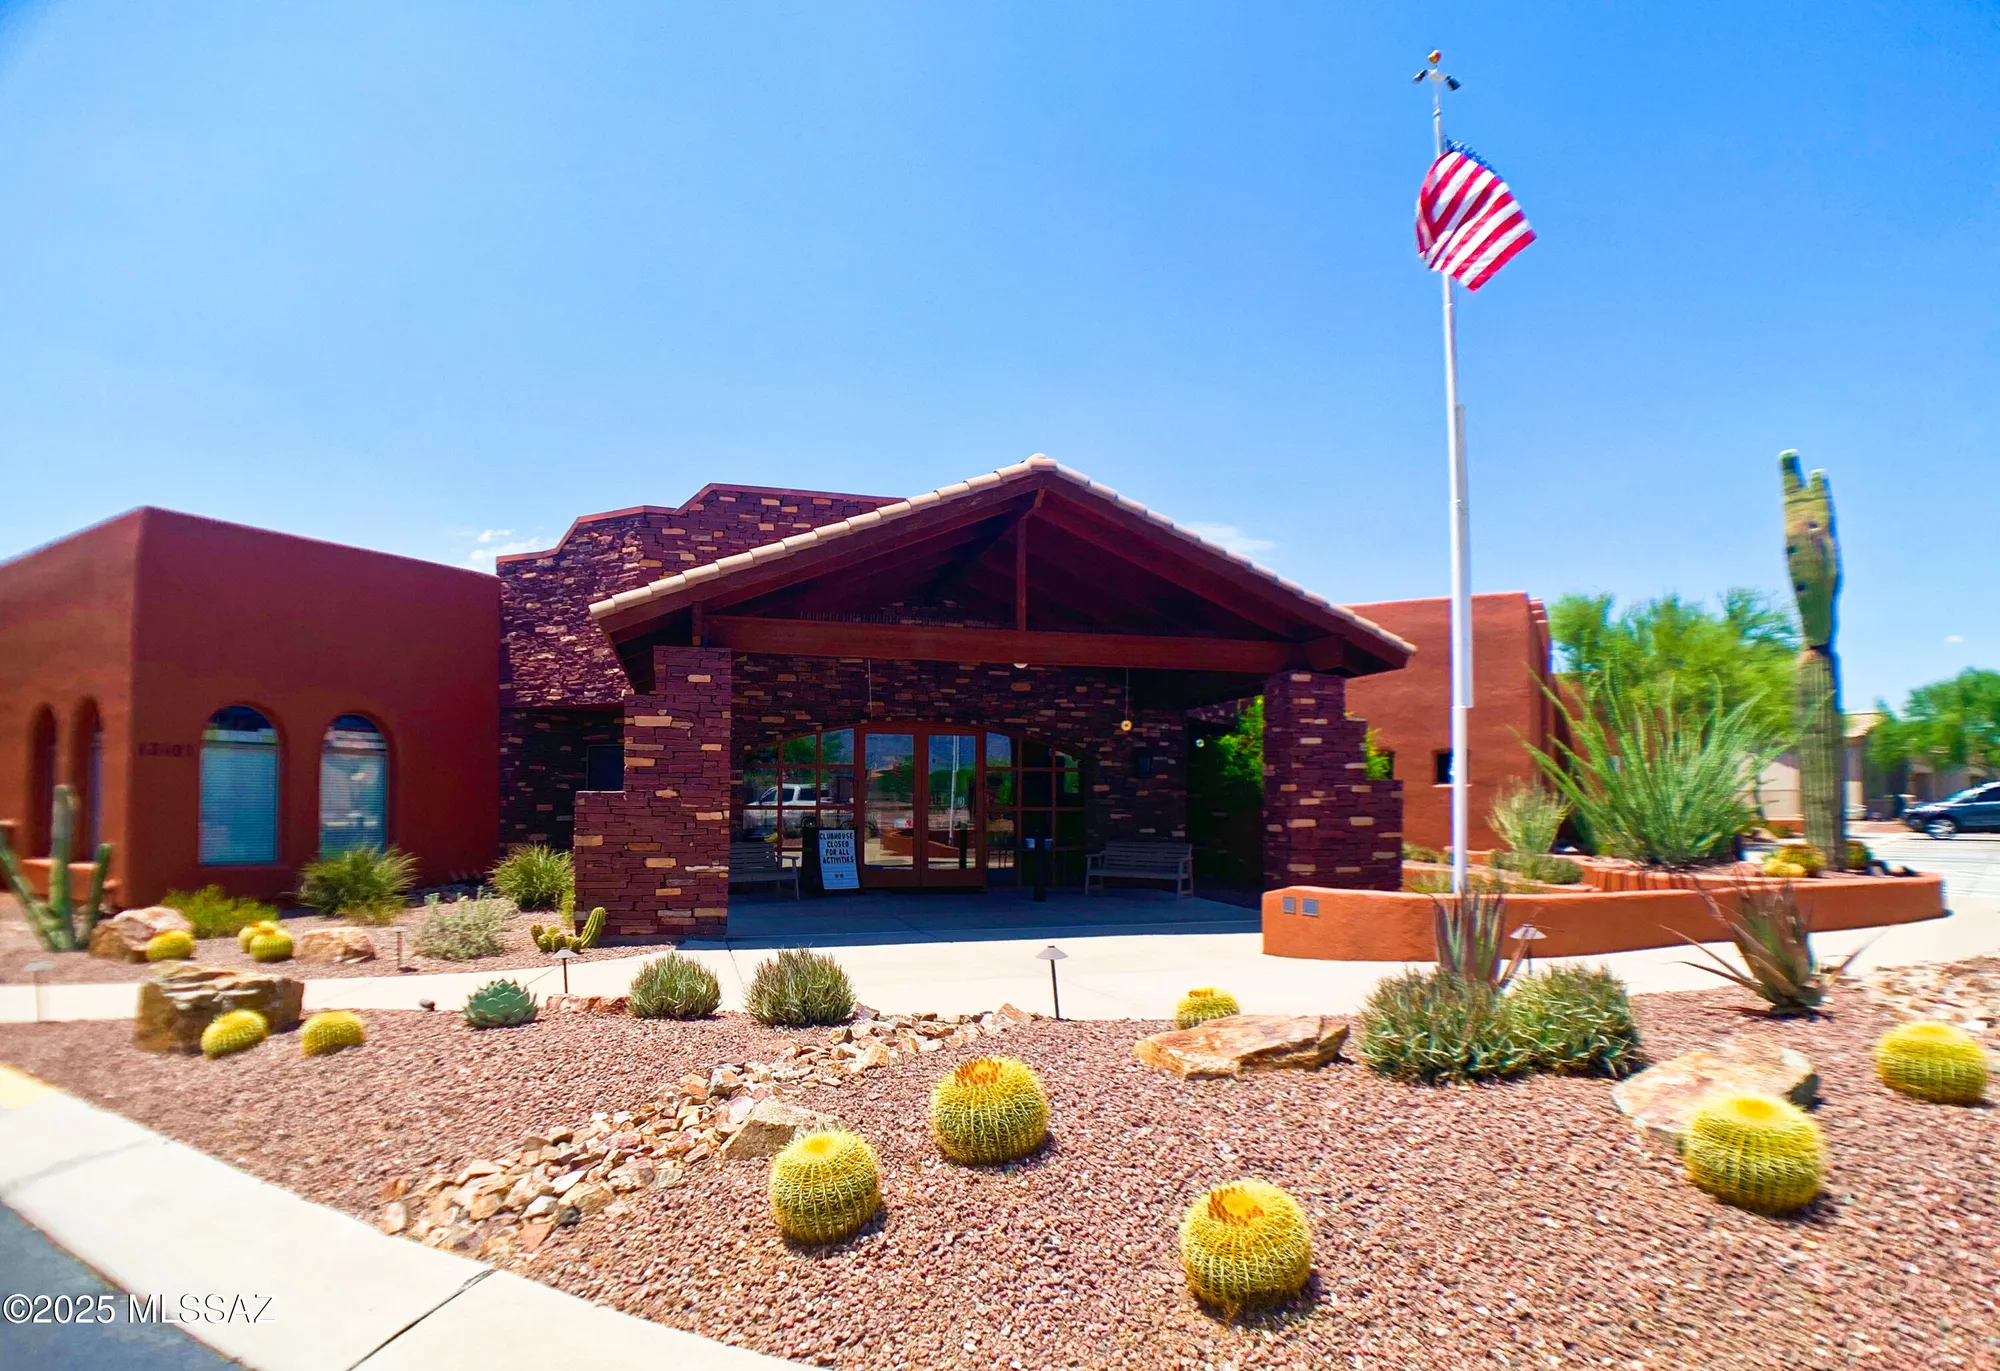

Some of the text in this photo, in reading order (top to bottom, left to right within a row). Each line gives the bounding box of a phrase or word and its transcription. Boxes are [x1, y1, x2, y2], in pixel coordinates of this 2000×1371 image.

[819, 832, 853, 840] CLUBHOUSE
[825, 848, 850, 856] FOR ALL
[823, 856, 854, 864] ACTIVITIES
